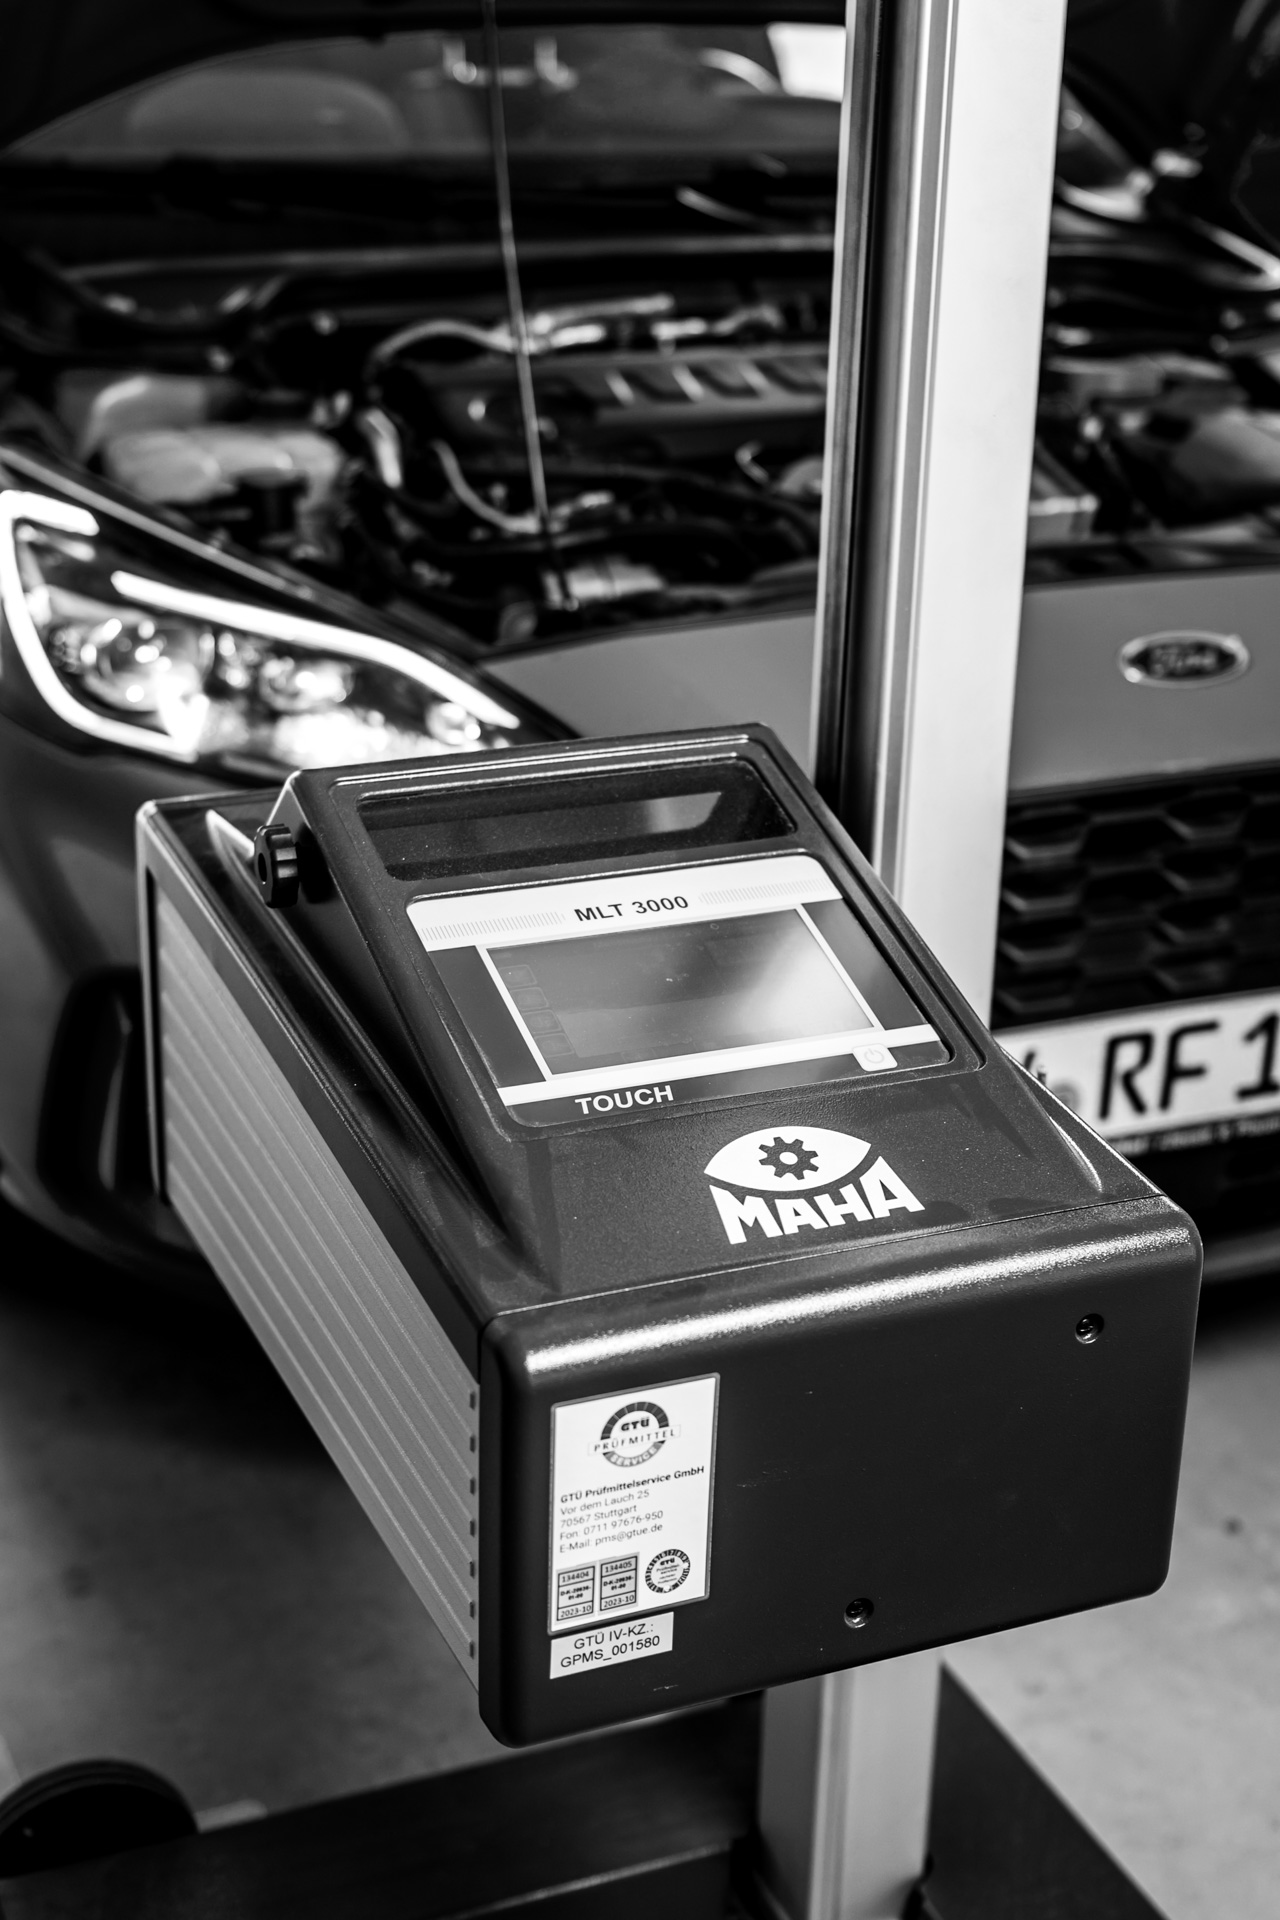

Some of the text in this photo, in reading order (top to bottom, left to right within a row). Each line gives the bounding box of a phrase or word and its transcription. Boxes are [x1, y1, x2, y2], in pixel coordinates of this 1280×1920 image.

[573, 894, 689, 923] MLT 3000
[1098, 1019, 1219, 1120] RF
[575, 1085, 674, 1115] TOUCH
[709, 1155, 925, 1245] MAHA
[621, 1417, 650, 1432] GTÜ
[594, 1429, 675, 1452] PRÜFMITTEL
[610, 1447, 657, 1466] SERVICE
[560, 1466, 705, 1504] GTÜ Prüfmittelservice GmbH
[560, 1489, 650, 1516] Vor dem Lauch 25
[560, 1504, 637, 1528] 70567 Stuttgart
[560, 1510, 664, 1541] Fon: 0711 97676-950
[560, 1523, 663, 1553] E-Mail: pms@gtue.de
[562, 1570, 590, 1583] 134404
[605, 1561, 632, 1573] 134405
[560, 1605, 592, 1618] 2023-10
[603, 1594, 635, 1608] 2023-10
[574, 1623, 654, 1650] GTÜ IV-KZ.:
[560, 1635, 660, 1668] GPMS_001580
